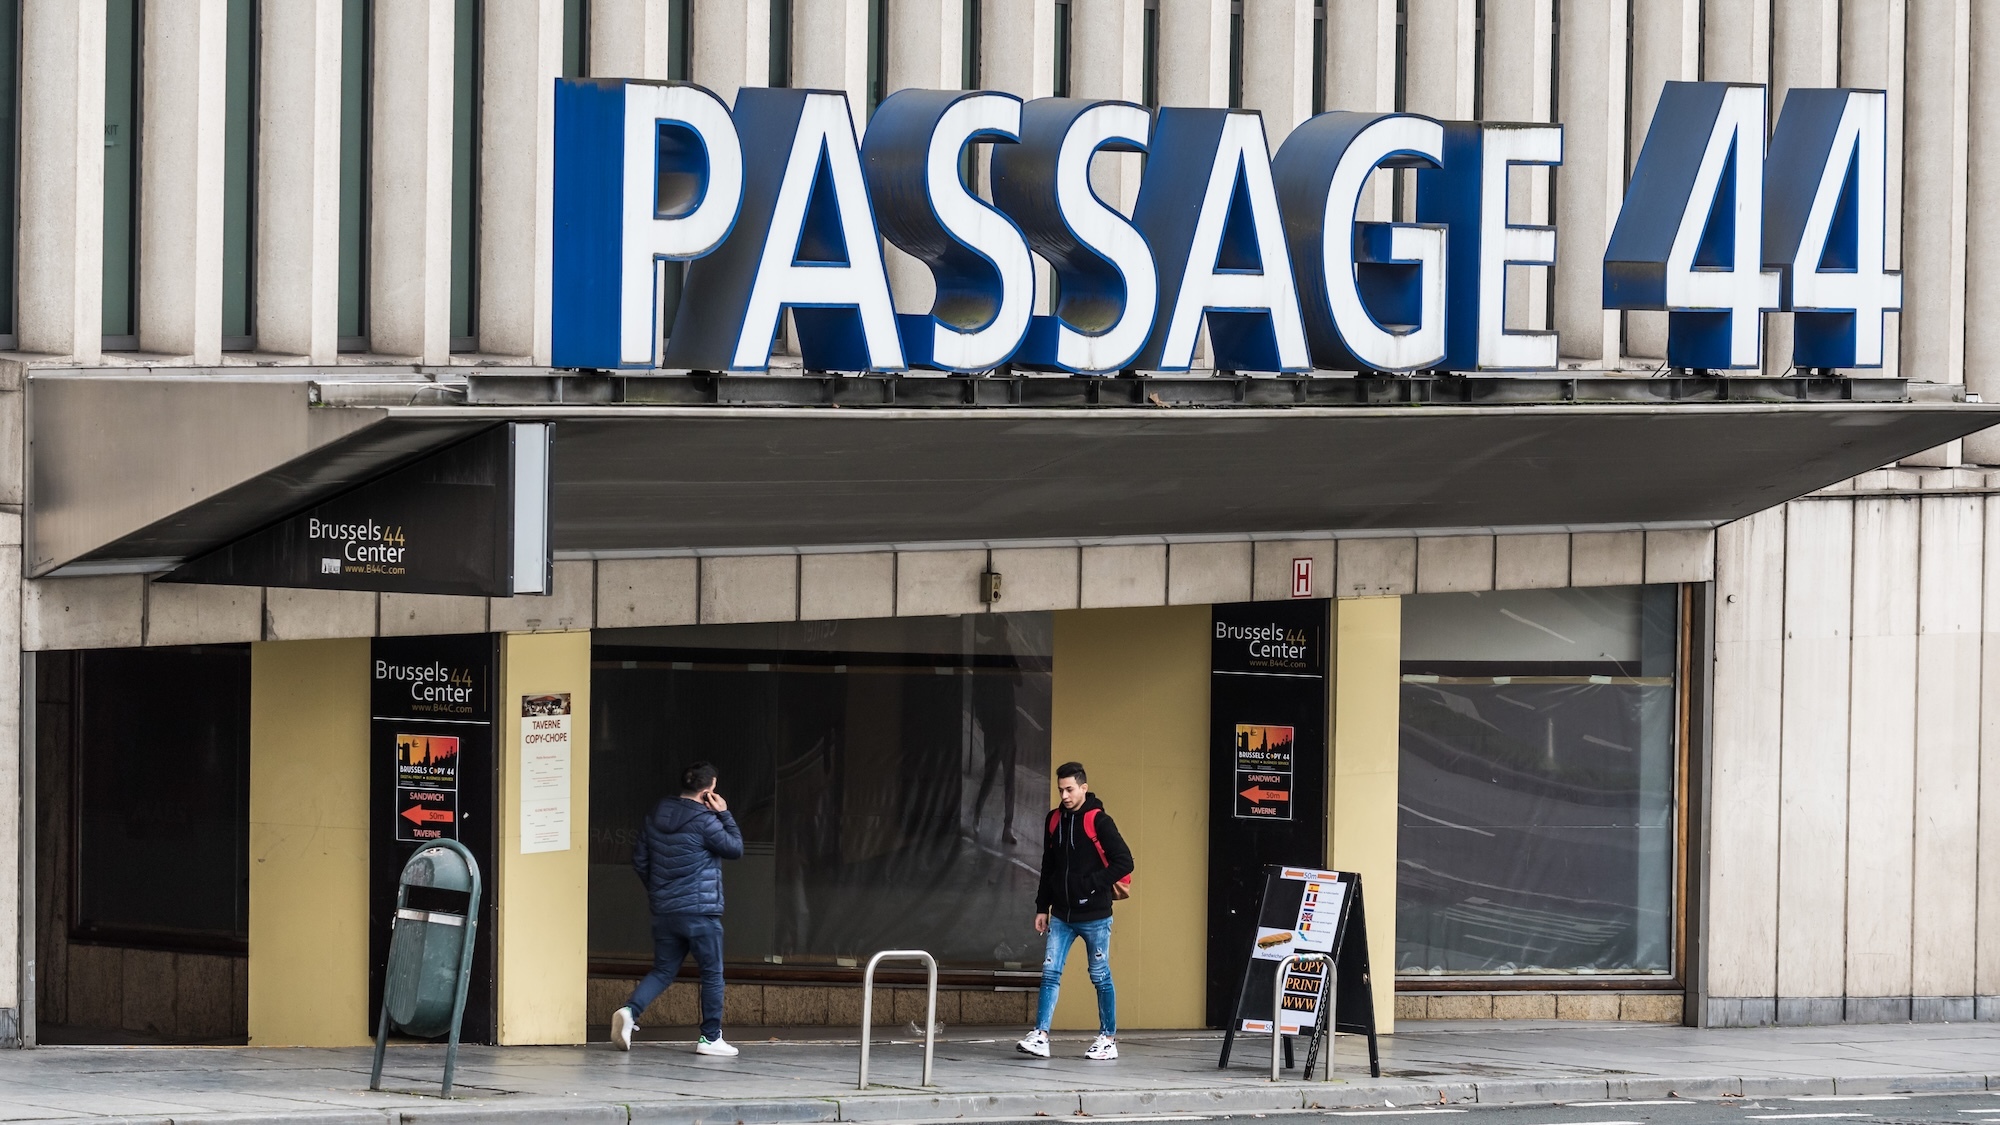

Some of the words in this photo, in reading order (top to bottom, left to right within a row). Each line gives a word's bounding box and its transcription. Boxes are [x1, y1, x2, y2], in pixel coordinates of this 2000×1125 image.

[612, 79, 1564, 374] PASSAGE
[1660, 80, 1902, 370] 44
[309, 518, 382, 540] Brussels
[383, 526, 406, 547] 44
[344, 540, 406, 563] Center
[344, 564, 406, 575] www.B44C.com
[1296, 563, 1309, 592] H
[1216, 621, 1284, 641] Brussels
[1285, 628, 1307, 645] 44
[1249, 640, 1307, 659] Center
[1249, 659, 1307, 669] www.B44C.com
[376, 660, 449, 682] Brussels
[450, 668, 473, 687] 44
[411, 681, 473, 702] Center
[411, 703, 473, 714] www.B44C.com
[532, 719, 561, 730] TAVERNE
[525, 732, 567, 744] COPY-CHOPE
[1238, 751, 1264, 759] BRUSSELS
[400, 766, 427, 774] BRUSSELS
[1248, 775, 1280, 783] SANDWICH
[410, 792, 444, 801] SANDWICH
[430, 812, 444, 820] 50m
[1251, 806, 1276, 815] TAVERNE
[412, 828, 442, 838] TAVERNE
[1304, 872, 1317, 880] 50m
[1292, 961, 1324, 974] COPY
[1285, 977, 1321, 992] PRINT
[1283, 995, 1317, 1011] WWW
